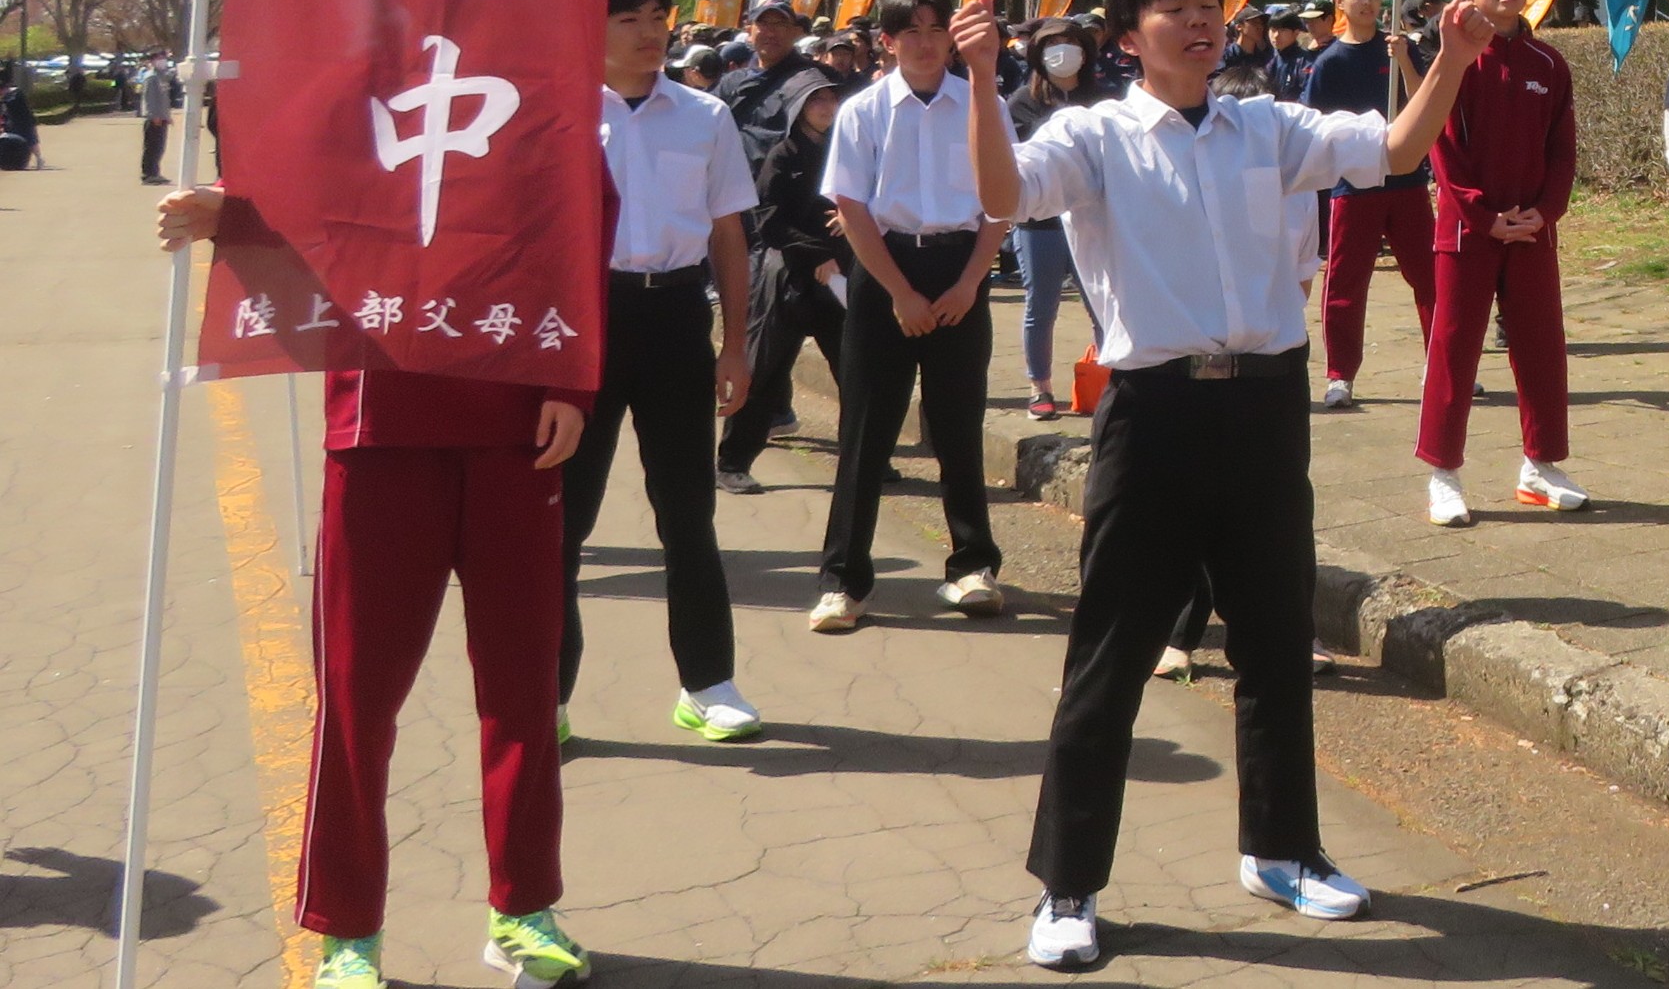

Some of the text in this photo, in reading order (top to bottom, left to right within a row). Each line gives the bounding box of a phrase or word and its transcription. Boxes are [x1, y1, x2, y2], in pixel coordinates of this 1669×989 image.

[234, 289, 579, 351] 陸上部父母会
